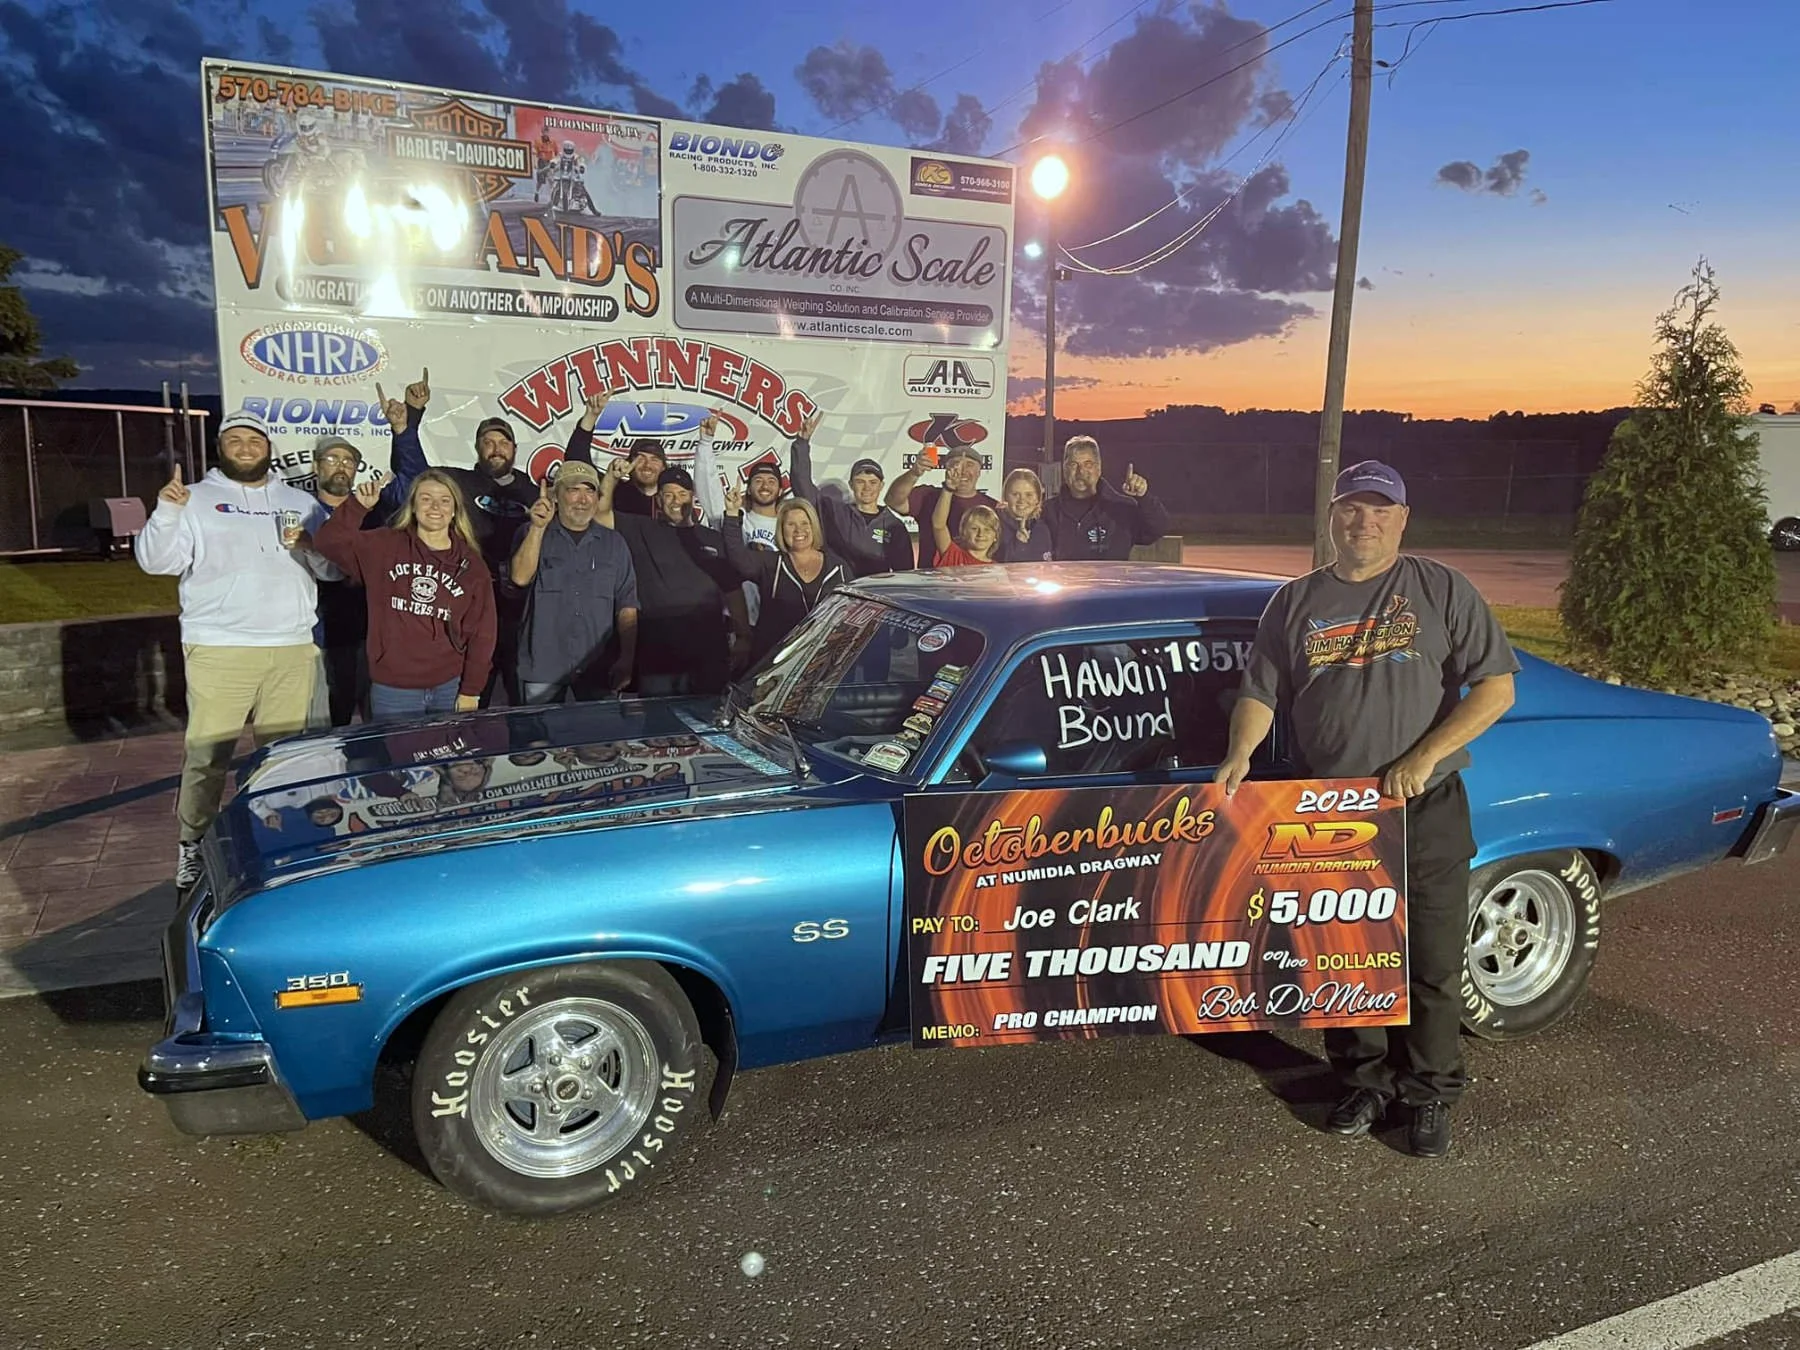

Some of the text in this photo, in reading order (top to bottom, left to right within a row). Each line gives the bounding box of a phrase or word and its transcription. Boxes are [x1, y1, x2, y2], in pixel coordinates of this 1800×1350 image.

[217, 74, 398, 117] 570-784-BIKE
[395, 134, 525, 170] HARLEY-DAVIDSON
[669, 131, 784, 161] BIONDO
[669, 152, 703, 162] RACING
[693, 163, 758, 177] 1-800-332-1320
[688, 217, 997, 287] Atlantic Scale
[427, 289, 447, 309] ON
[450, 290, 512, 313] ANOTHER
[515, 294, 613, 318] CHAMPIONSHIP
[690, 292, 990, 322] A Multi-Dimensional Weighing Solution and Calibration Service Provider
[264, 332, 371, 374] NHRA
[267, 368, 367, 387] DRAG RACING
[498, 335, 817, 438] WINNERS
[910, 386, 982, 395] AUTO STORE
[295, 426, 364, 437] PRODUCTS,
[389, 562, 465, 598] LOCK HAVEN
[1306, 637, 1331, 655] JIM
[1057, 696, 1176, 750] Bound
[1295, 788, 1382, 814] 2022
[923, 796, 1216, 877] Octoberbucks
[1260, 819, 1380, 860] ND
[975, 852, 1162, 889] AT NUMIDIA DRAGWAY
[1253, 858, 1382, 875] NUMIDIA DRAGWAY
[912, 896, 1142, 934] PAY TO: Joe Clark
[1247, 886, 1397, 927] $ 5,000
[791, 918, 850, 942] SS
[286, 971, 349, 990] 350
[922, 952, 1014, 985] FIVE
[1026, 940, 1251, 978] THOUSAND
[1315, 950, 1402, 972] DOLLARS
[921, 980, 1398, 1040] MEMO: PRO CHAMPION Bob DiMino
[431, 984, 532, 1119] Hoosier
[607, 1064, 696, 1194] Hoosier
